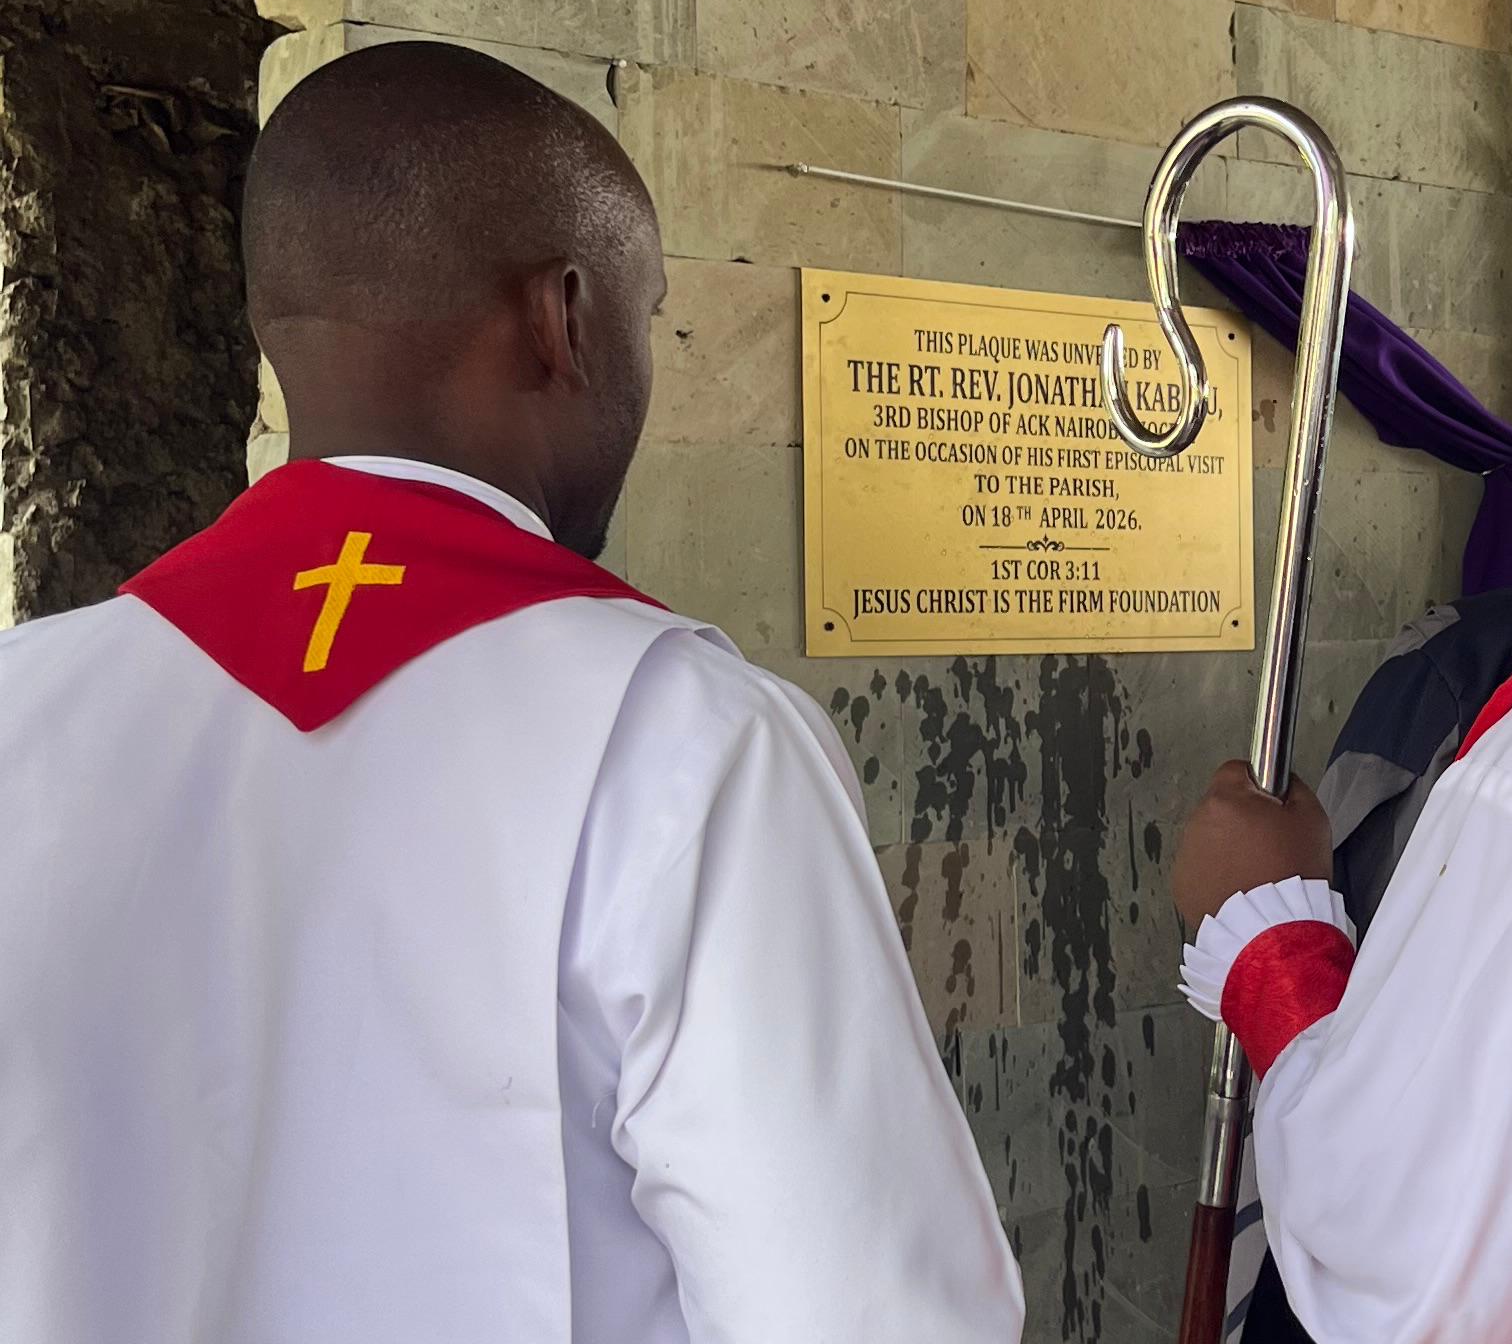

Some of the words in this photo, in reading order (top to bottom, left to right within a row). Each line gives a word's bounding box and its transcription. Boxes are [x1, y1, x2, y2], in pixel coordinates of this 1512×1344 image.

[914, 329, 953, 354] THIS
[958, 333, 1021, 363] PLAQUE
[1025, 339, 1059, 363] WAS
[1063, 343, 1139, 369] UNVED
[1143, 349, 1162, 371] BY
[847, 360, 901, 395] THE
[908, 364, 944, 398] RT.
[951, 367, 1001, 402] REV.
[1008, 371, 1128, 410] JONATH
[1136, 381, 1223, 421] KABU,
[873, 405, 911, 429] 3RD
[917, 407, 984, 432] BISHOP
[989, 412, 1012, 434] OF
[1016, 414, 1051, 437] ACK
[1055, 415, 1126, 441] NAIROB
[845, 437, 870, 459] ON
[875, 439, 910, 460] THE
[915, 441, 997, 464] OCCASION
[1002, 446, 1022, 466] OF
[1027, 447, 1053, 467] HIS
[1057, 449, 1101, 469] FIRST
[1105, 451, 1184, 473] EPISCOPAL
[1187, 455, 1224, 475] VISIT
[974, 474, 1000, 494] TO
[1005, 476, 1044, 495] THE
[1049, 477, 1119, 500] PARISH,
[962, 505, 986, 527] ON
[1039, 507, 1088, 529] APRIL
[1095, 509, 1142, 531] 2026.
[991, 560, 1022, 580] 1ST
[1027, 560, 1061, 580] COR
[1065, 561, 1100, 581] 3:11
[853, 589, 911, 620] JESUS
[916, 589, 988, 614] CHRIST
[994, 589, 1010, 614] IS
[1015, 589, 1053, 614] THE
[1058, 590, 1103, 614] FIRM
[1109, 590, 1221, 614] FOUNDATION
